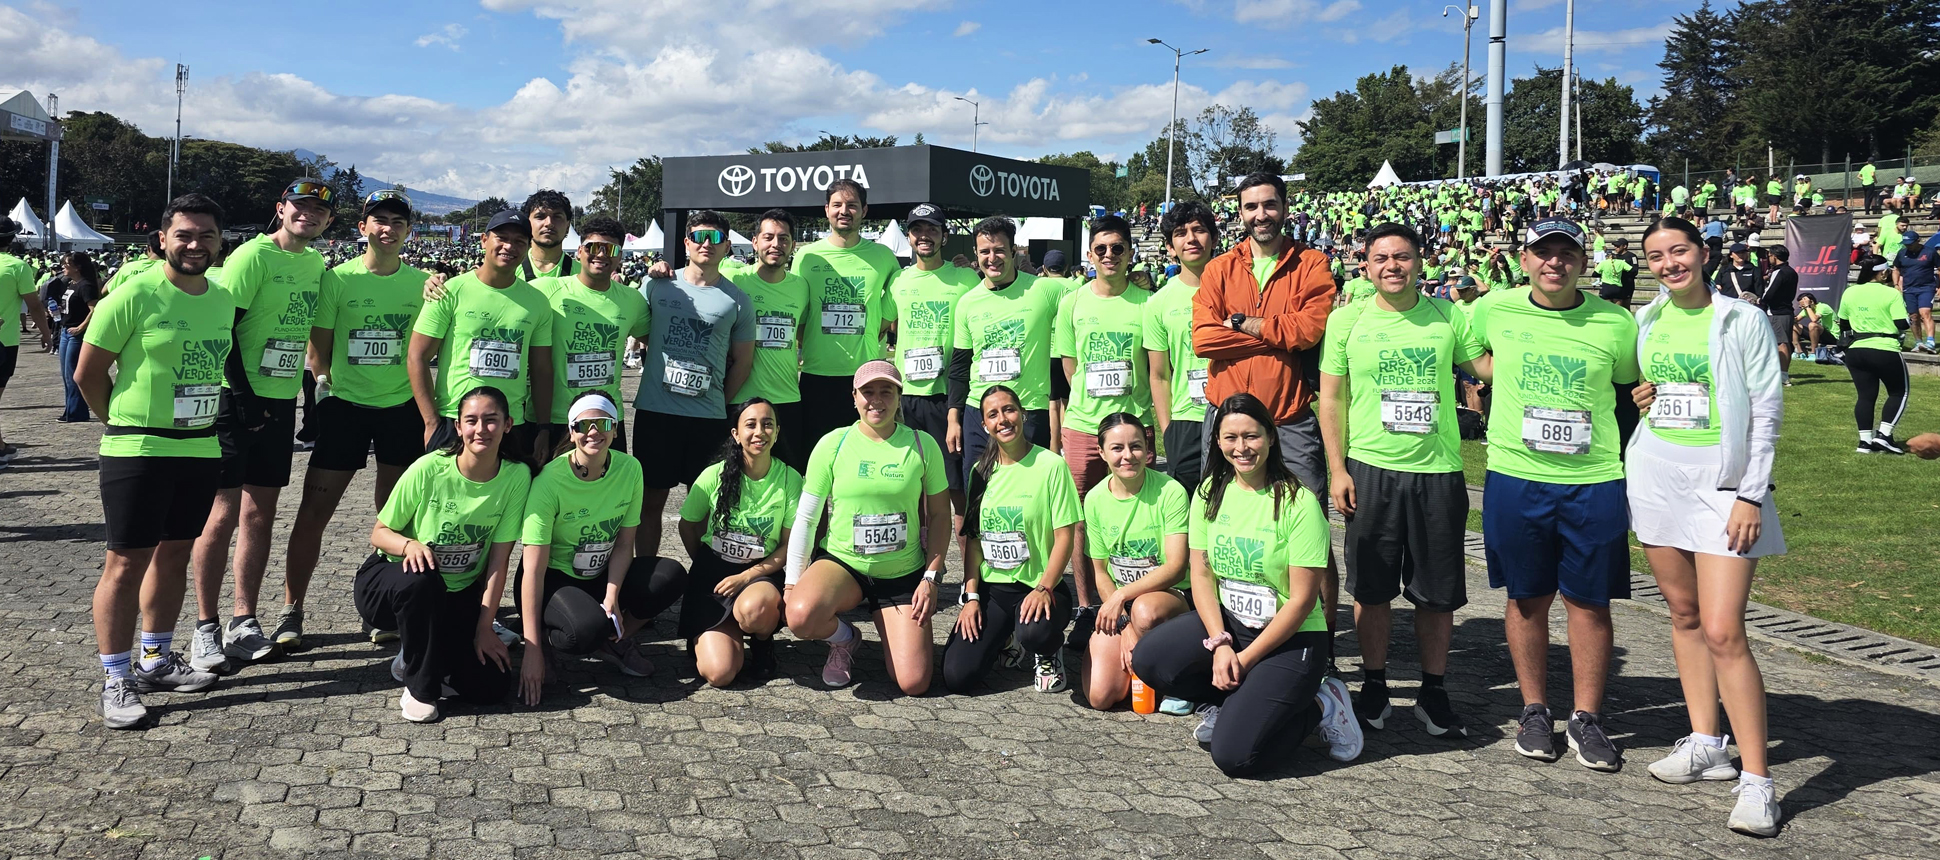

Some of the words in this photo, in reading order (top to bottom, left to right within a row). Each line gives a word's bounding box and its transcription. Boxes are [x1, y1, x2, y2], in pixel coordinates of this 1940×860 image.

[760, 164, 870, 193] TOYOTA
[997, 171, 1060, 201] TOYOTA
[834, 313, 854, 326] 712
[766, 327, 786, 340] 706
[182, 340, 202, 352] CA
[363, 342, 388, 355] 700
[278, 353, 299, 368] 692
[485, 353, 508, 368] 690
[1379, 349, 1400, 361] CA
[1522, 351, 1545, 366] CA
[1651, 352, 1670, 364] CA
[578, 363, 607, 378] 5553
[913, 358, 933, 371] 709
[988, 360, 1007, 373] 710
[669, 370, 704, 389] 10326
[1098, 373, 1121, 387] 708
[1563, 390, 1586, 399] 2026
[193, 398, 217, 416] 717
[1394, 405, 1432, 422] 5548
[1541, 423, 1573, 442] 689
[864, 527, 897, 544] 5543
[1215, 534, 1233, 547] CA
[721, 541, 753, 559] 5557
[990, 544, 1018, 560] 5560
[1229, 593, 1262, 616] 5549
